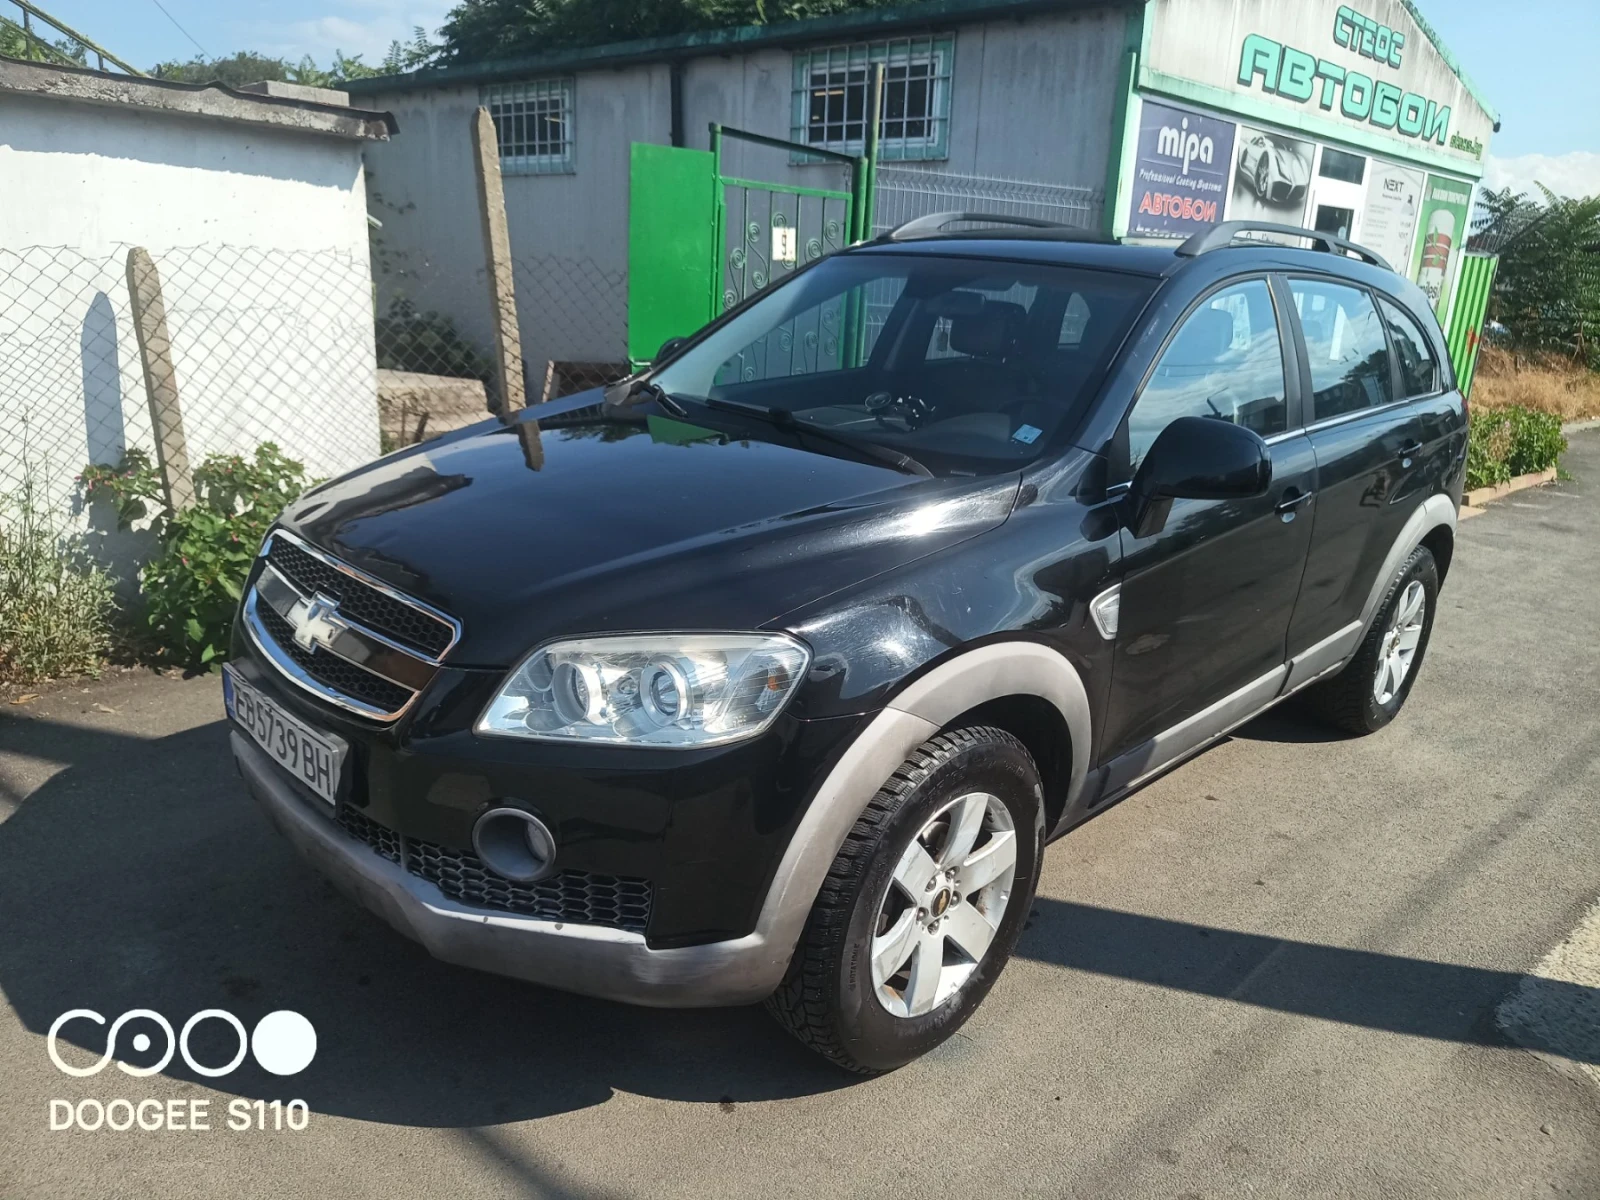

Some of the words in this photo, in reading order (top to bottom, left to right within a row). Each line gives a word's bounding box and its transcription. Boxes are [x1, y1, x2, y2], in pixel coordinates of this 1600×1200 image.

[1333, 4, 1405, 70] СТЕОС
[1157, 116, 1213, 175] mipa
[1138, 168, 1175, 184] Professional
[1175, 175, 1197, 191] Coating
[1383, 178, 1405, 194] NEXT
[1138, 191, 1217, 223] АВТОБОИ
